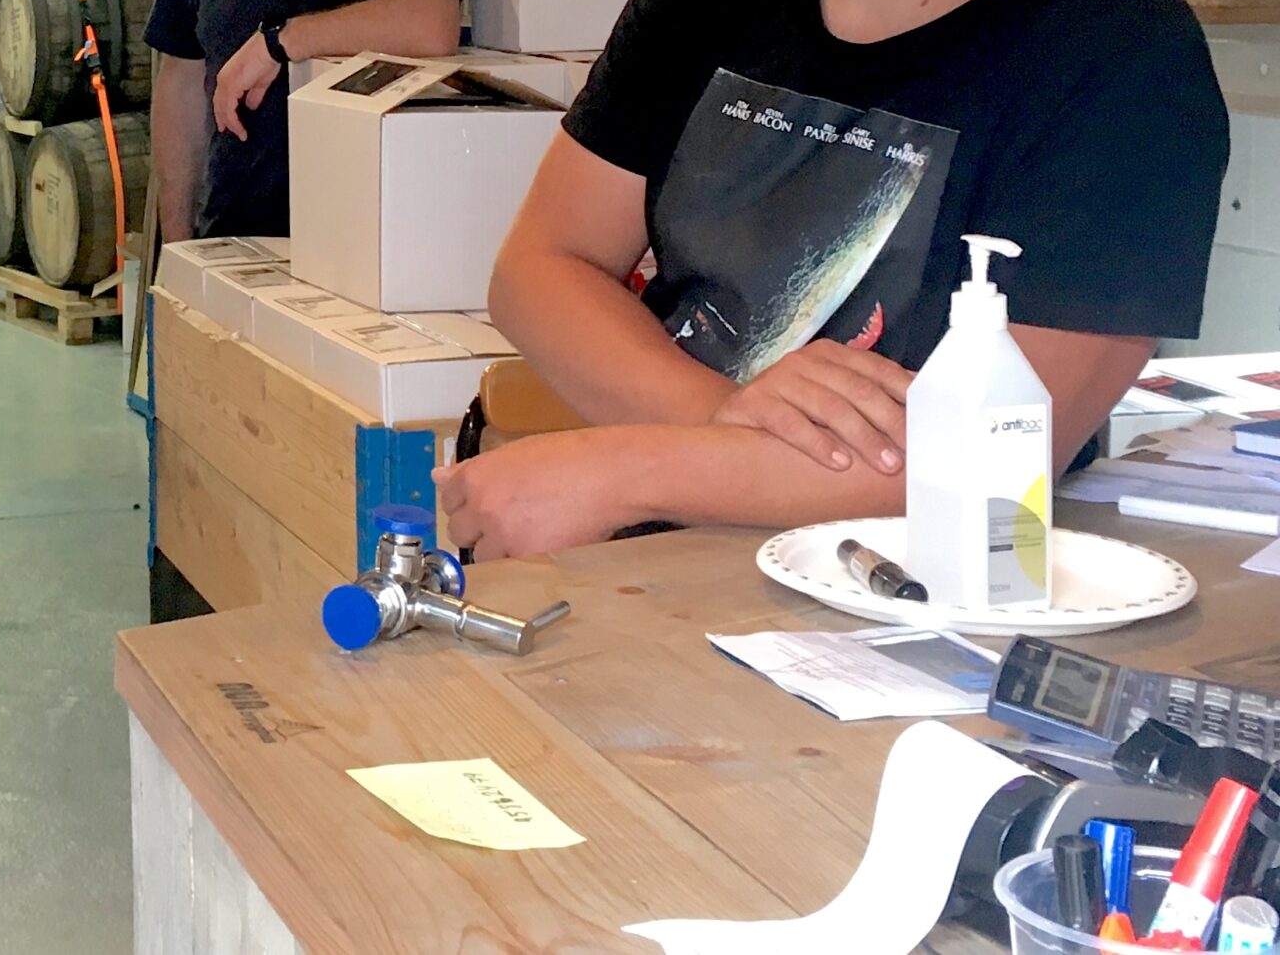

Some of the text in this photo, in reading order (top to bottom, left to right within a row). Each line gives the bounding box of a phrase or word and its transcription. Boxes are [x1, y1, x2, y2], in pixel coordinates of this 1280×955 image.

[753, 112, 794, 133] BACON
[841, 132, 876, 151] SINISE
[885, 145, 927, 167] HARRIS
